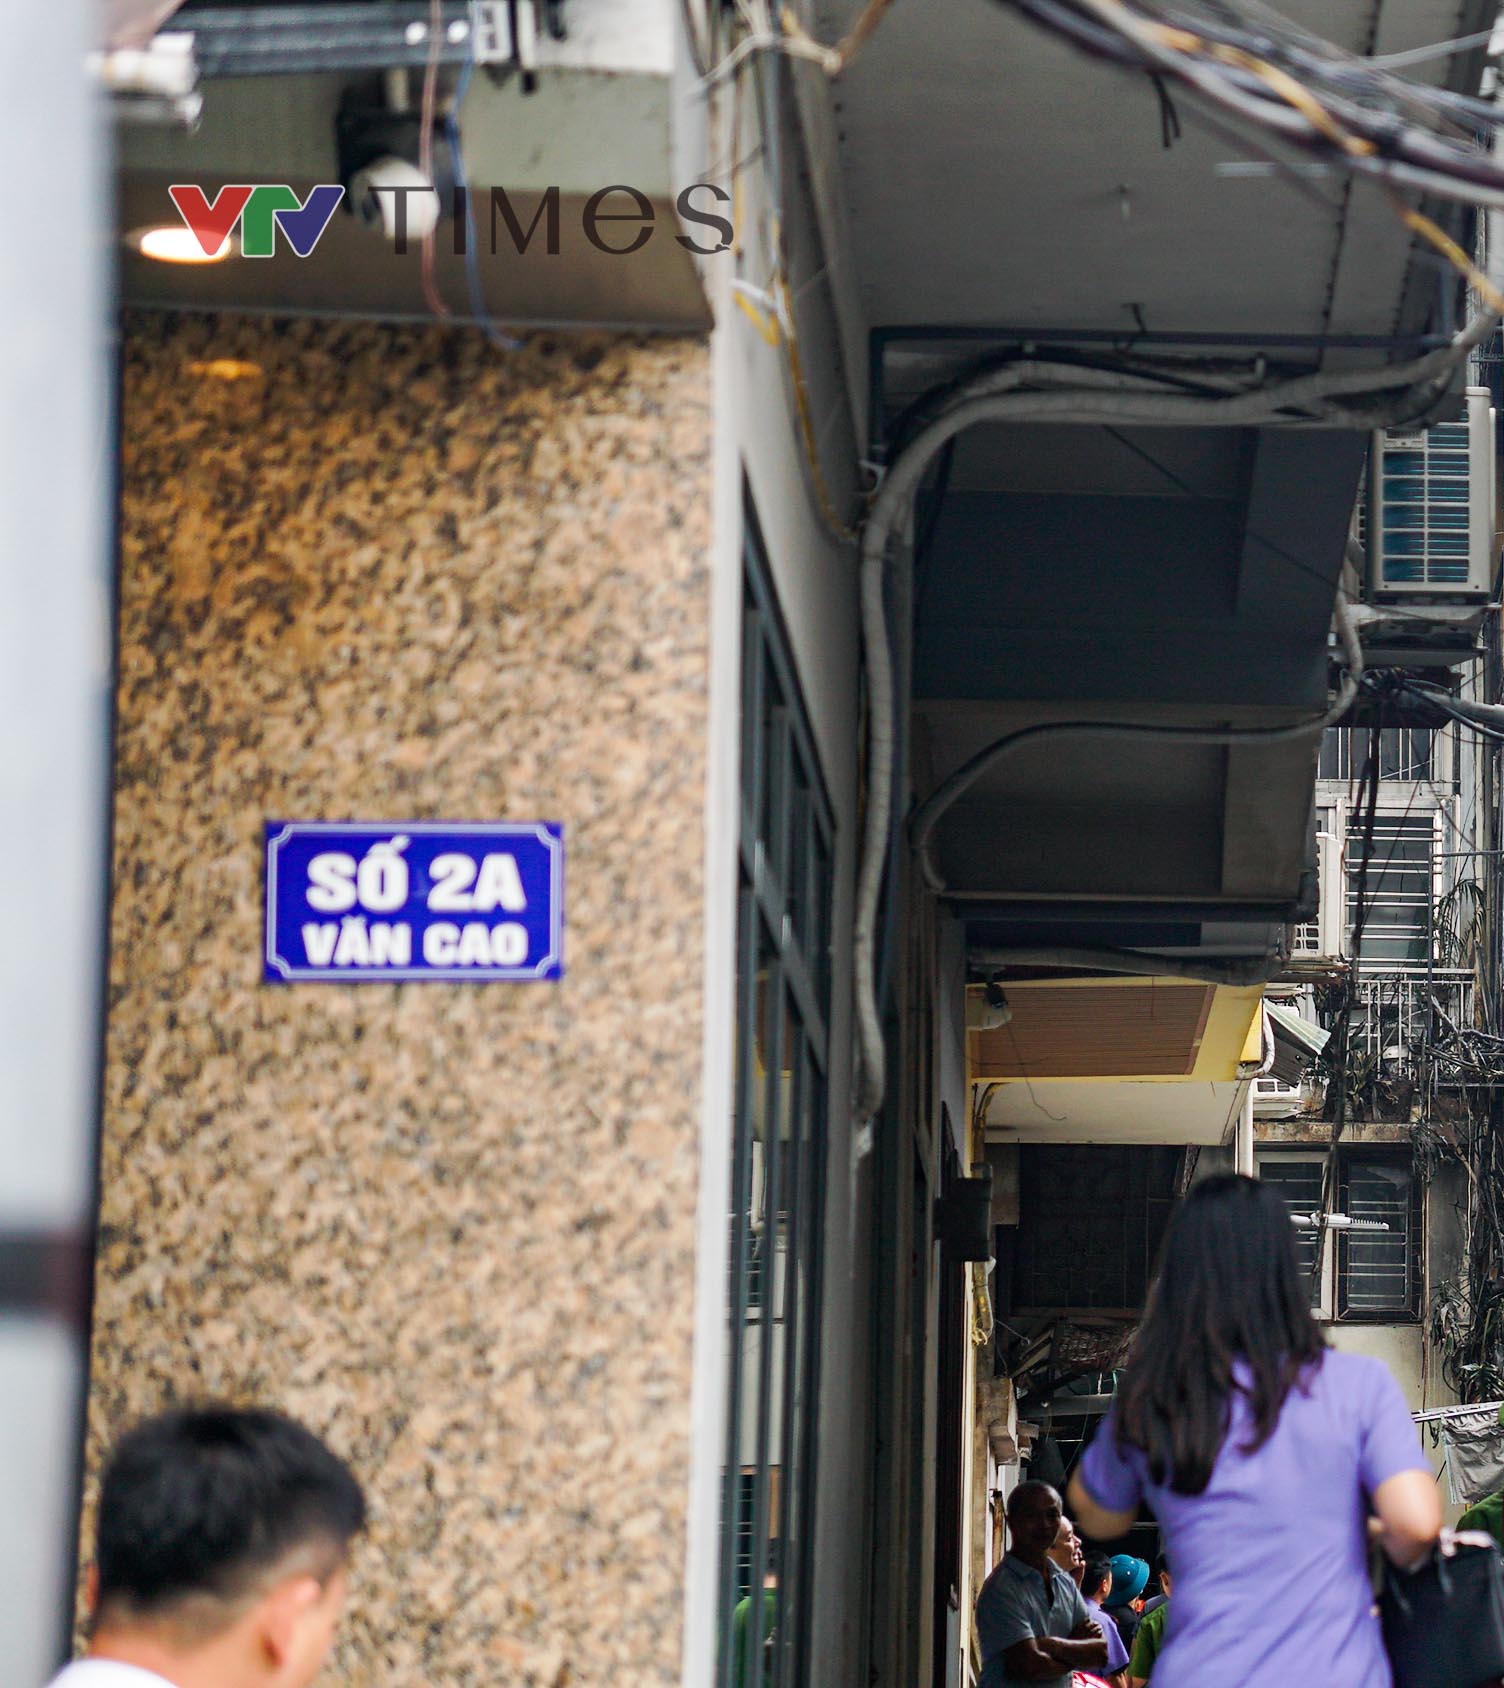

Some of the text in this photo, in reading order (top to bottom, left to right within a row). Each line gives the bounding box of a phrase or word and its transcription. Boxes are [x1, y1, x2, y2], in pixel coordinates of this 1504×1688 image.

[305, 834, 528, 914] SỐ 2A
[301, 914, 530, 966] VĂN CAO
